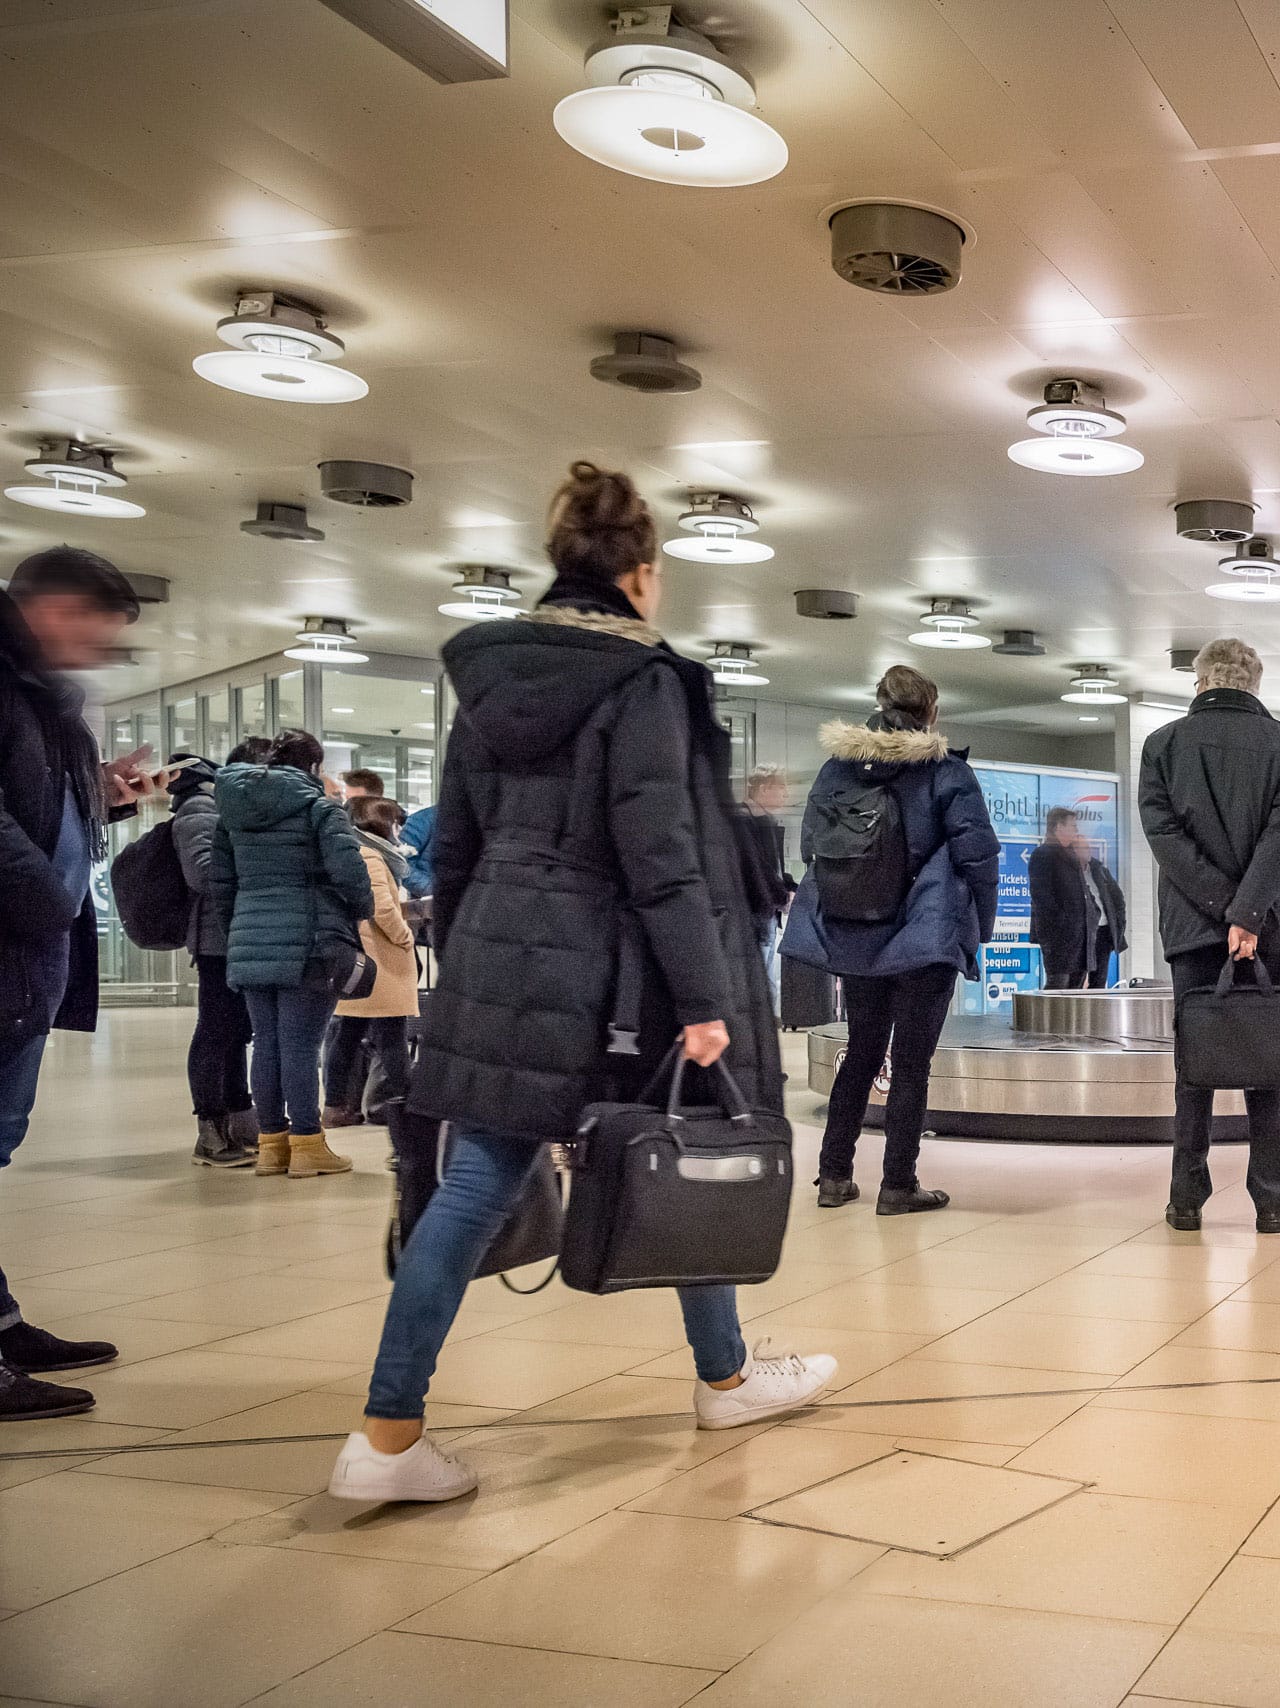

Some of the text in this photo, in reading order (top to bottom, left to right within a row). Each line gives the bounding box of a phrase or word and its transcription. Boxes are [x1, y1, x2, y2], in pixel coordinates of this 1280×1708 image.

[999, 873, 1028, 885] Tickets
[998, 886, 1021, 897] uttle
[999, 919, 1024, 928] Terminal
